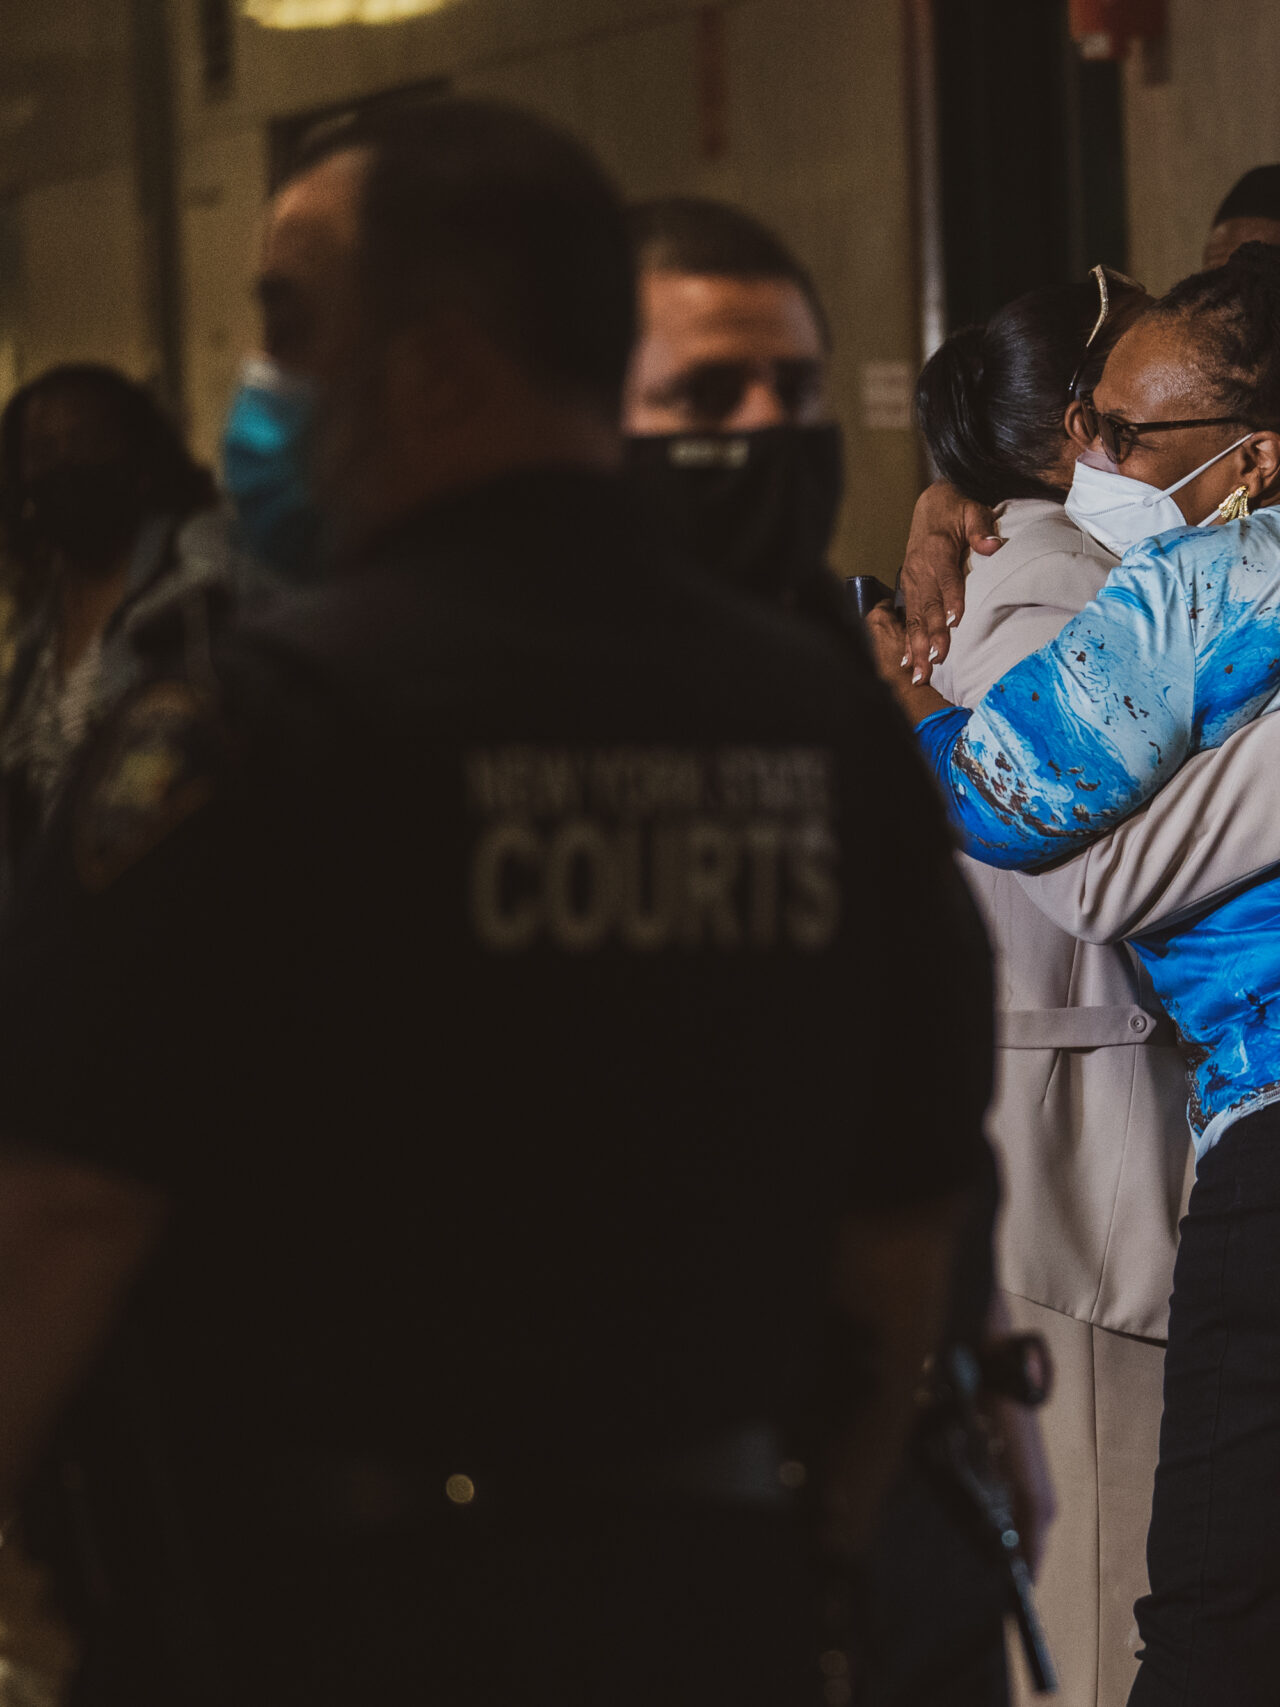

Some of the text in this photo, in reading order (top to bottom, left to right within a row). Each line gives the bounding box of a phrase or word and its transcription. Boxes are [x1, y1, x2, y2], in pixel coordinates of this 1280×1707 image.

[467, 745, 581, 810] NEW
[586, 744, 701, 810] YORK
[471, 822, 841, 952] COURTS
